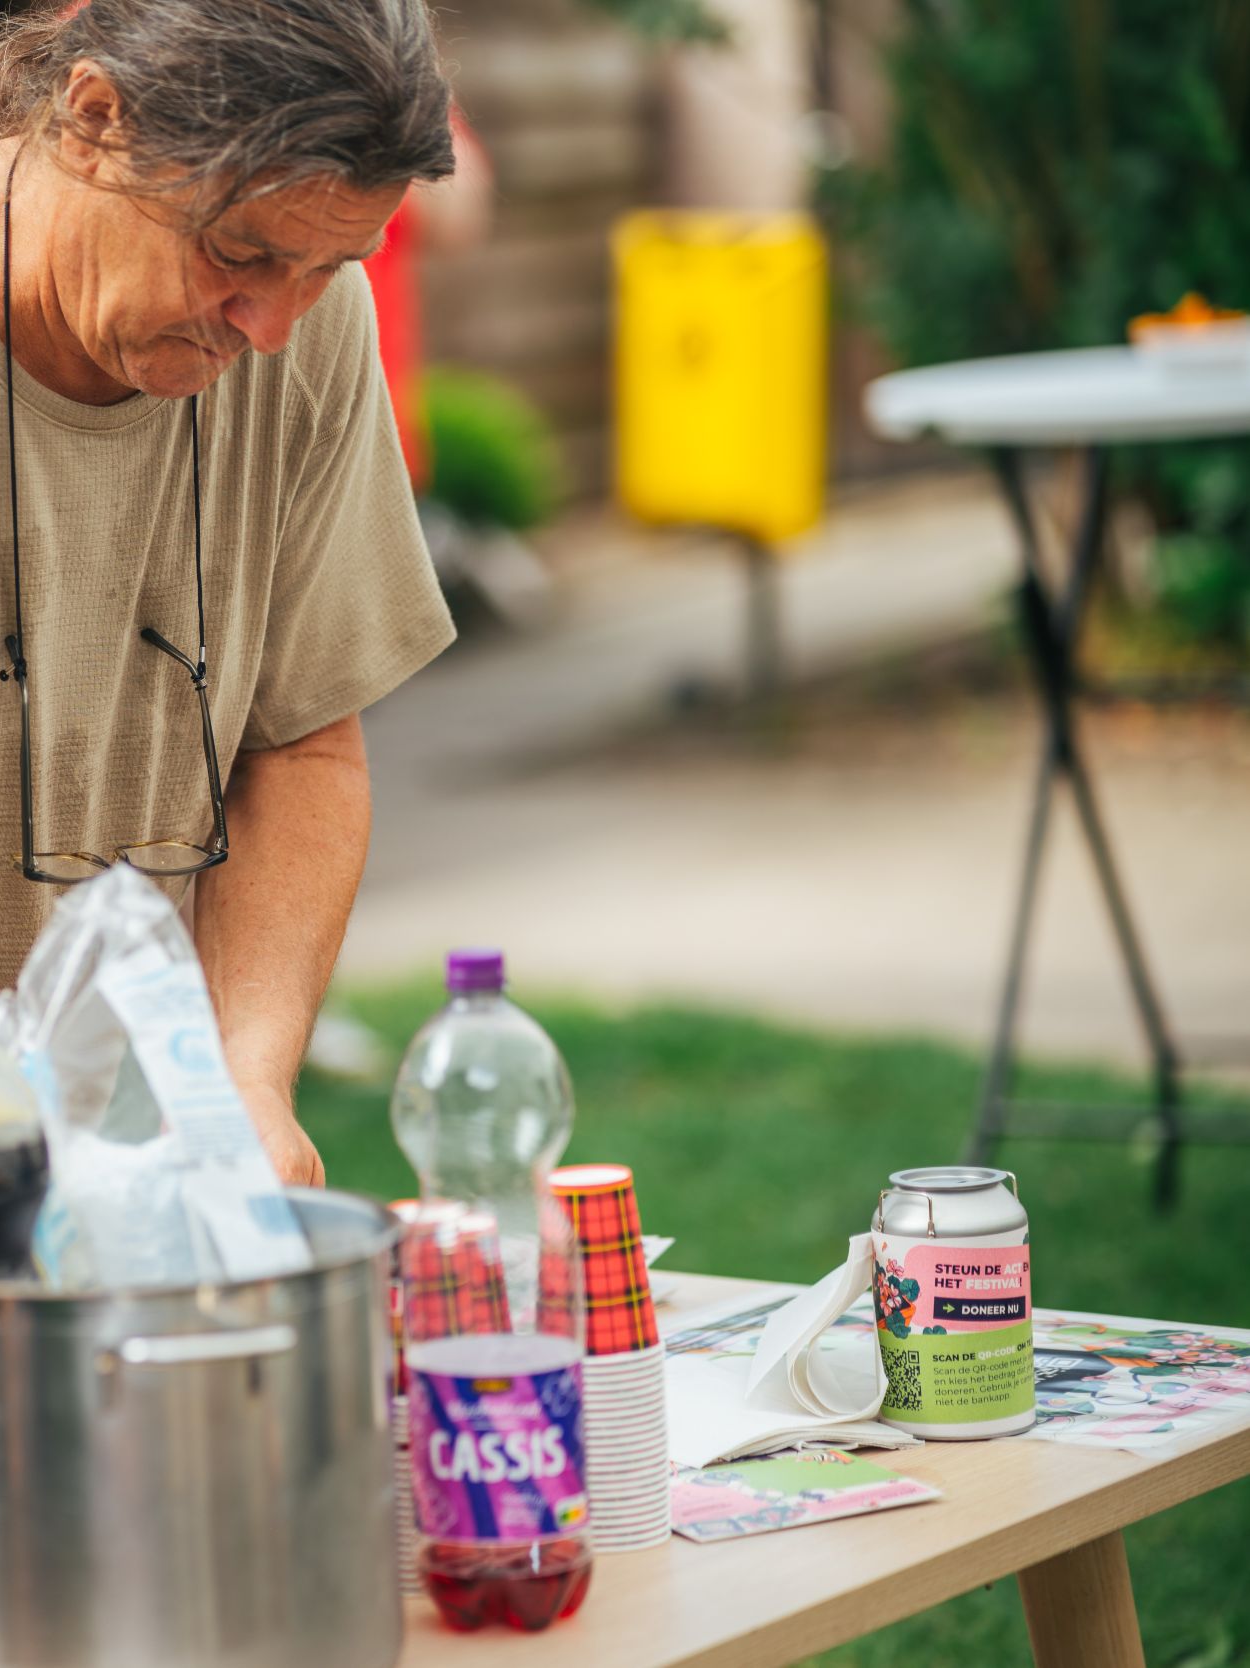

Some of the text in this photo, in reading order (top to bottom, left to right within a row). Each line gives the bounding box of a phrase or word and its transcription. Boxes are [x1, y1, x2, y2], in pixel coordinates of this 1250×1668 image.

[935, 1263, 980, 1275] STEUN
[984, 1264, 1002, 1276] DE
[1004, 1262, 1023, 1275] ACT
[934, 1277, 963, 1289] HET
[961, 1303, 1020, 1315] DONEER NU
[932, 1353, 960, 1363] SCAN
[962, 1352, 976, 1362] DE
[933, 1367, 956, 1376] Scan
[958, 1366, 971, 1375] de
[972, 1360, 1009, 1374] QR-code
[948, 1376, 968, 1386] kies
[970, 1374, 986, 1384] het
[987, 1369, 1016, 1383] bedrag
[979, 1381, 1012, 1393] Gebruik
[935, 1397, 956, 1407] niet
[956, 1396, 969, 1406] de
[428, 1423, 566, 1483] CASSIS
